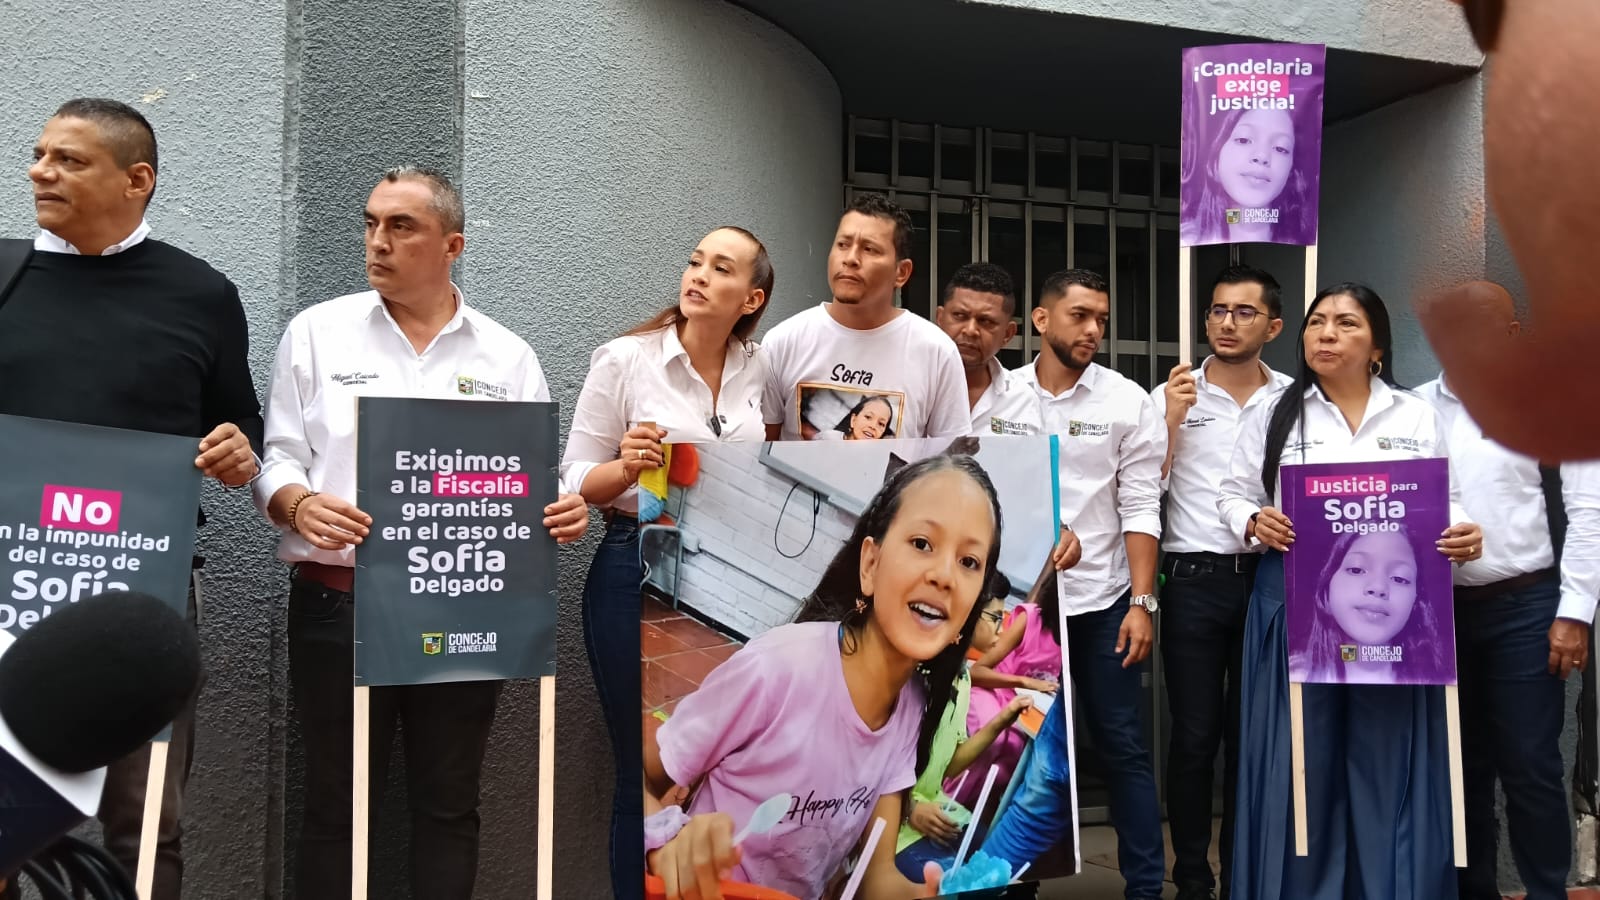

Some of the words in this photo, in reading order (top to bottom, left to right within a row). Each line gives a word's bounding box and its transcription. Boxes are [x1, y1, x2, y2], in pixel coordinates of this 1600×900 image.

[1193, 58, 1312, 82] ¡Candelaria
[1224, 76, 1281, 96] exige
[1210, 94, 1295, 115] justicia!
[1244, 208, 1279, 218] CONCEJO
[476, 380, 507, 396] CONCEJO
[1004, 421, 1027, 431] CONCEJO
[1083, 423, 1109, 431] CONCEJO
[395, 448, 521, 476] Exigimos
[390, 479, 404, 494] a
[411, 476, 431, 494] la
[437, 475, 524, 494] Fiscalía
[1310, 476, 1387, 494] Justicia
[1391, 481, 1418, 493] para
[51, 492, 113, 526] No
[401, 498, 513, 521] garantías
[1324, 493, 1406, 521] Sofía
[0, 525, 12, 539] n
[18, 523, 39, 541] la
[45, 524, 170, 551] impunidad
[382, 525, 411, 540] en
[417, 522, 438, 540] el
[444, 525, 498, 540] caso
[503, 522, 531, 540] de
[1331, 520, 1400, 536] Delgado
[8, 545, 47, 564] del
[51, 551, 106, 569] caso
[111, 553, 141, 571] de
[407, 541, 506, 573] Sofía
[410, 575, 504, 597] Delgado
[448, 631, 497, 646] CONCEJO
[448, 645, 457, 654] DE
[458, 644, 497, 653] CANDELARIA
[1361, 645, 1402, 656] CONCEJO
[784, 790, 844, 826] Happy
